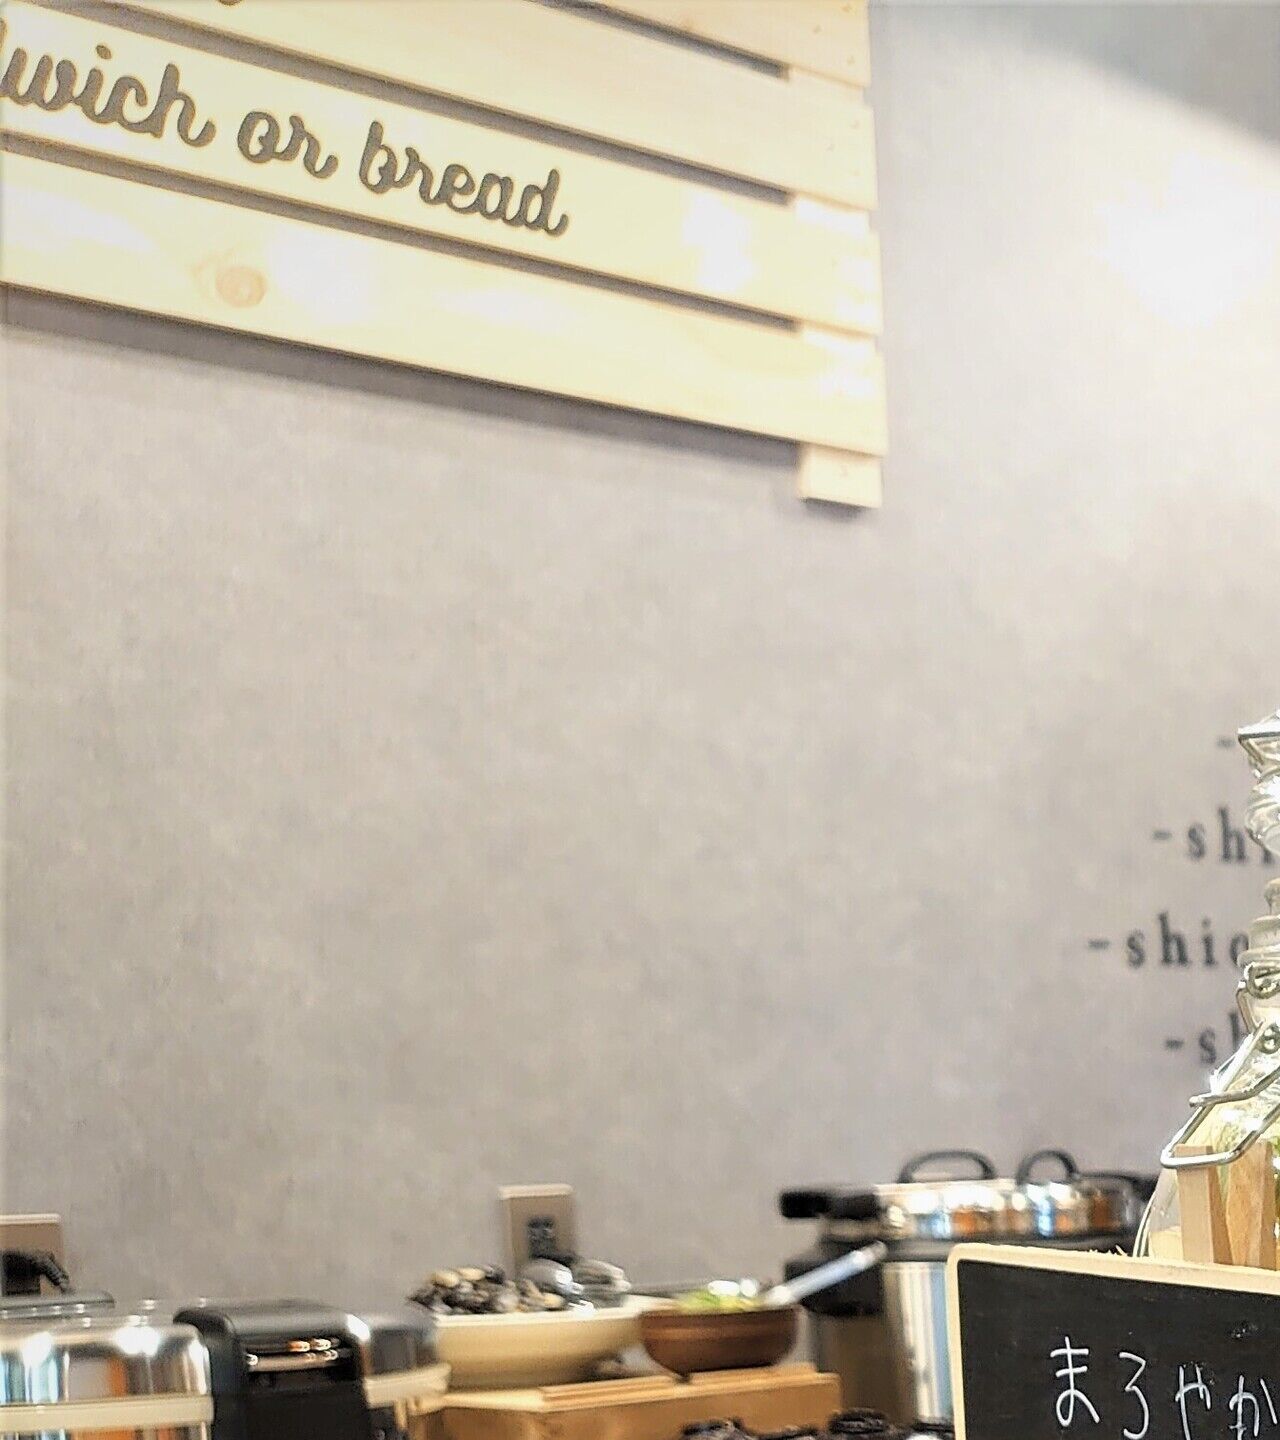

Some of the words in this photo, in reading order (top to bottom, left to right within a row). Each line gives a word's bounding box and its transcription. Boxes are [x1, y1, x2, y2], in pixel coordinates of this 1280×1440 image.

[0, 17, 216, 147] wich
[237, 111, 337, 178] or
[359, 121, 569, 236] bread
